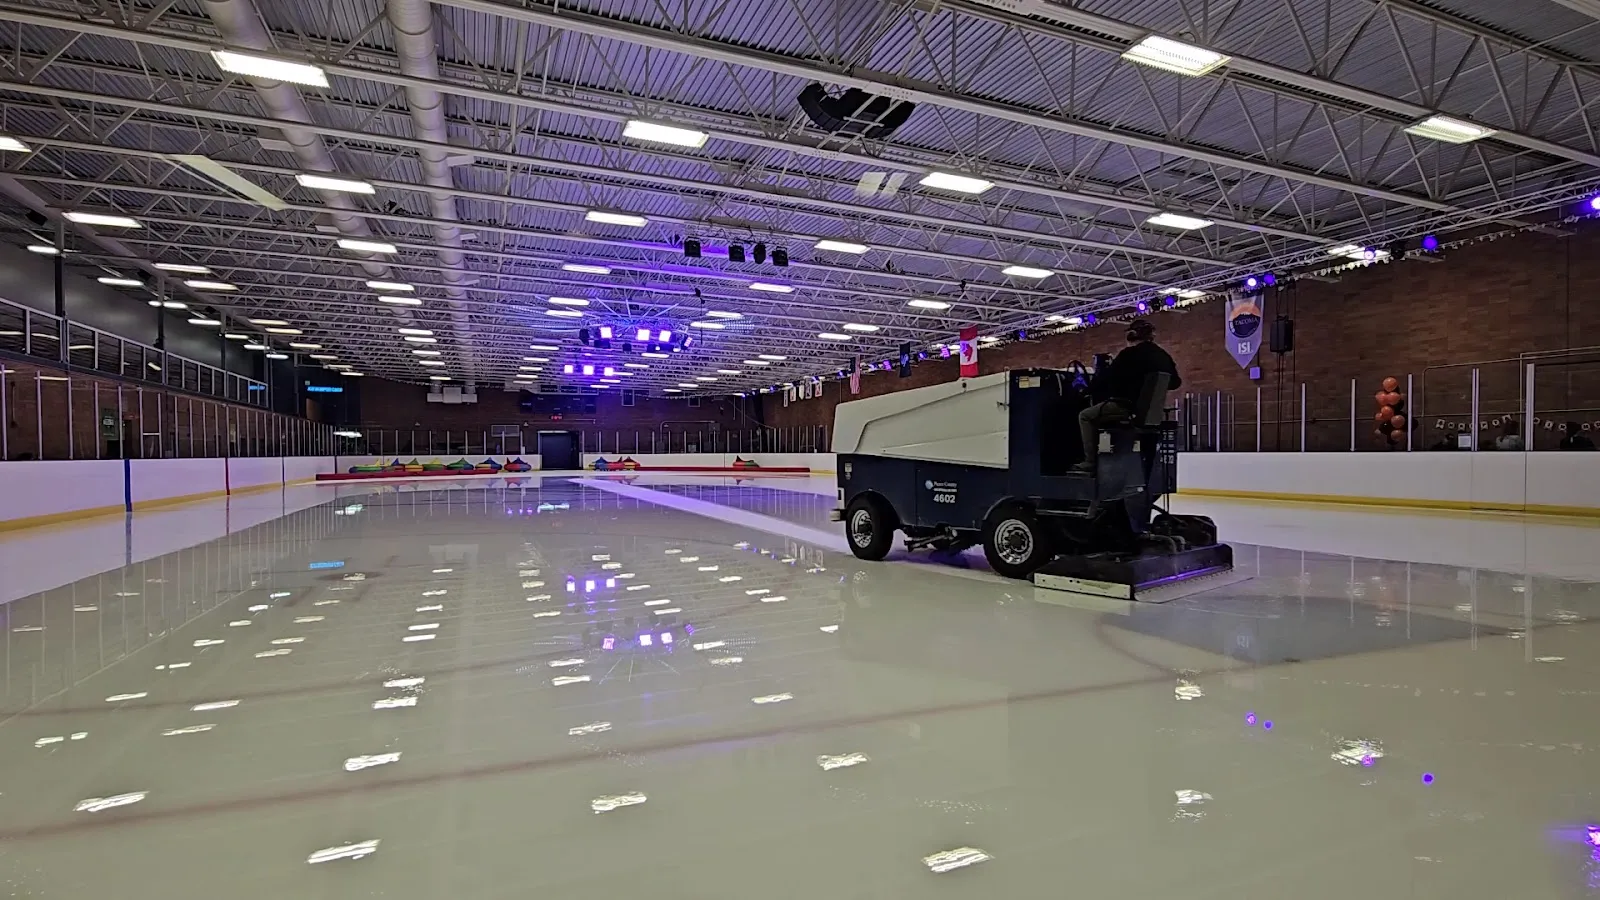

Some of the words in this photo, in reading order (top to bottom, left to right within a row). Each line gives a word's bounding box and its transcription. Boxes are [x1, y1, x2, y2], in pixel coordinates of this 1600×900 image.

[1234, 316, 1259, 326] TACOMA
[1238, 341, 1251, 354] ISI
[933, 494, 956, 504] 4602
